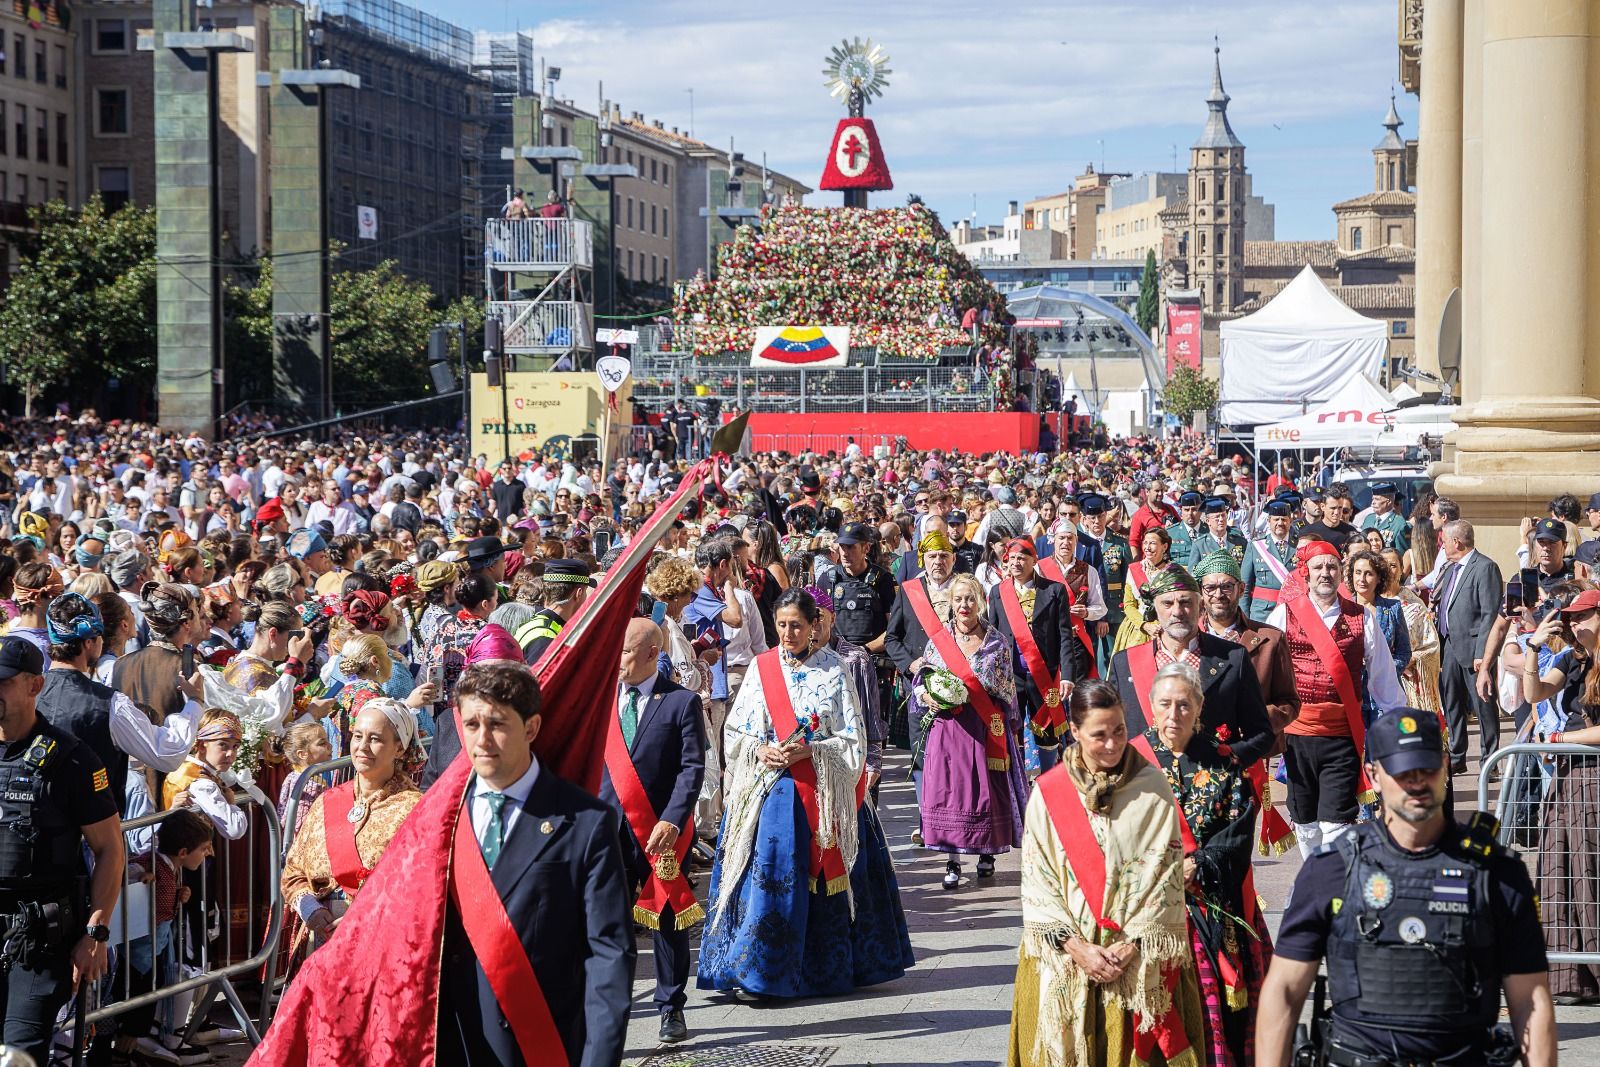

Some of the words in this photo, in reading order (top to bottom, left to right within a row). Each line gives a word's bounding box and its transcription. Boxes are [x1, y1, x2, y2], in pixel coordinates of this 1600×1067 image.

[526, 399, 561, 408] Zaragoza
[1317, 409, 1396, 425] rne
[1267, 427, 1300, 442] rtve
[4, 791, 34, 801] POLICIA
[1428, 901, 1469, 914] POLICIA
